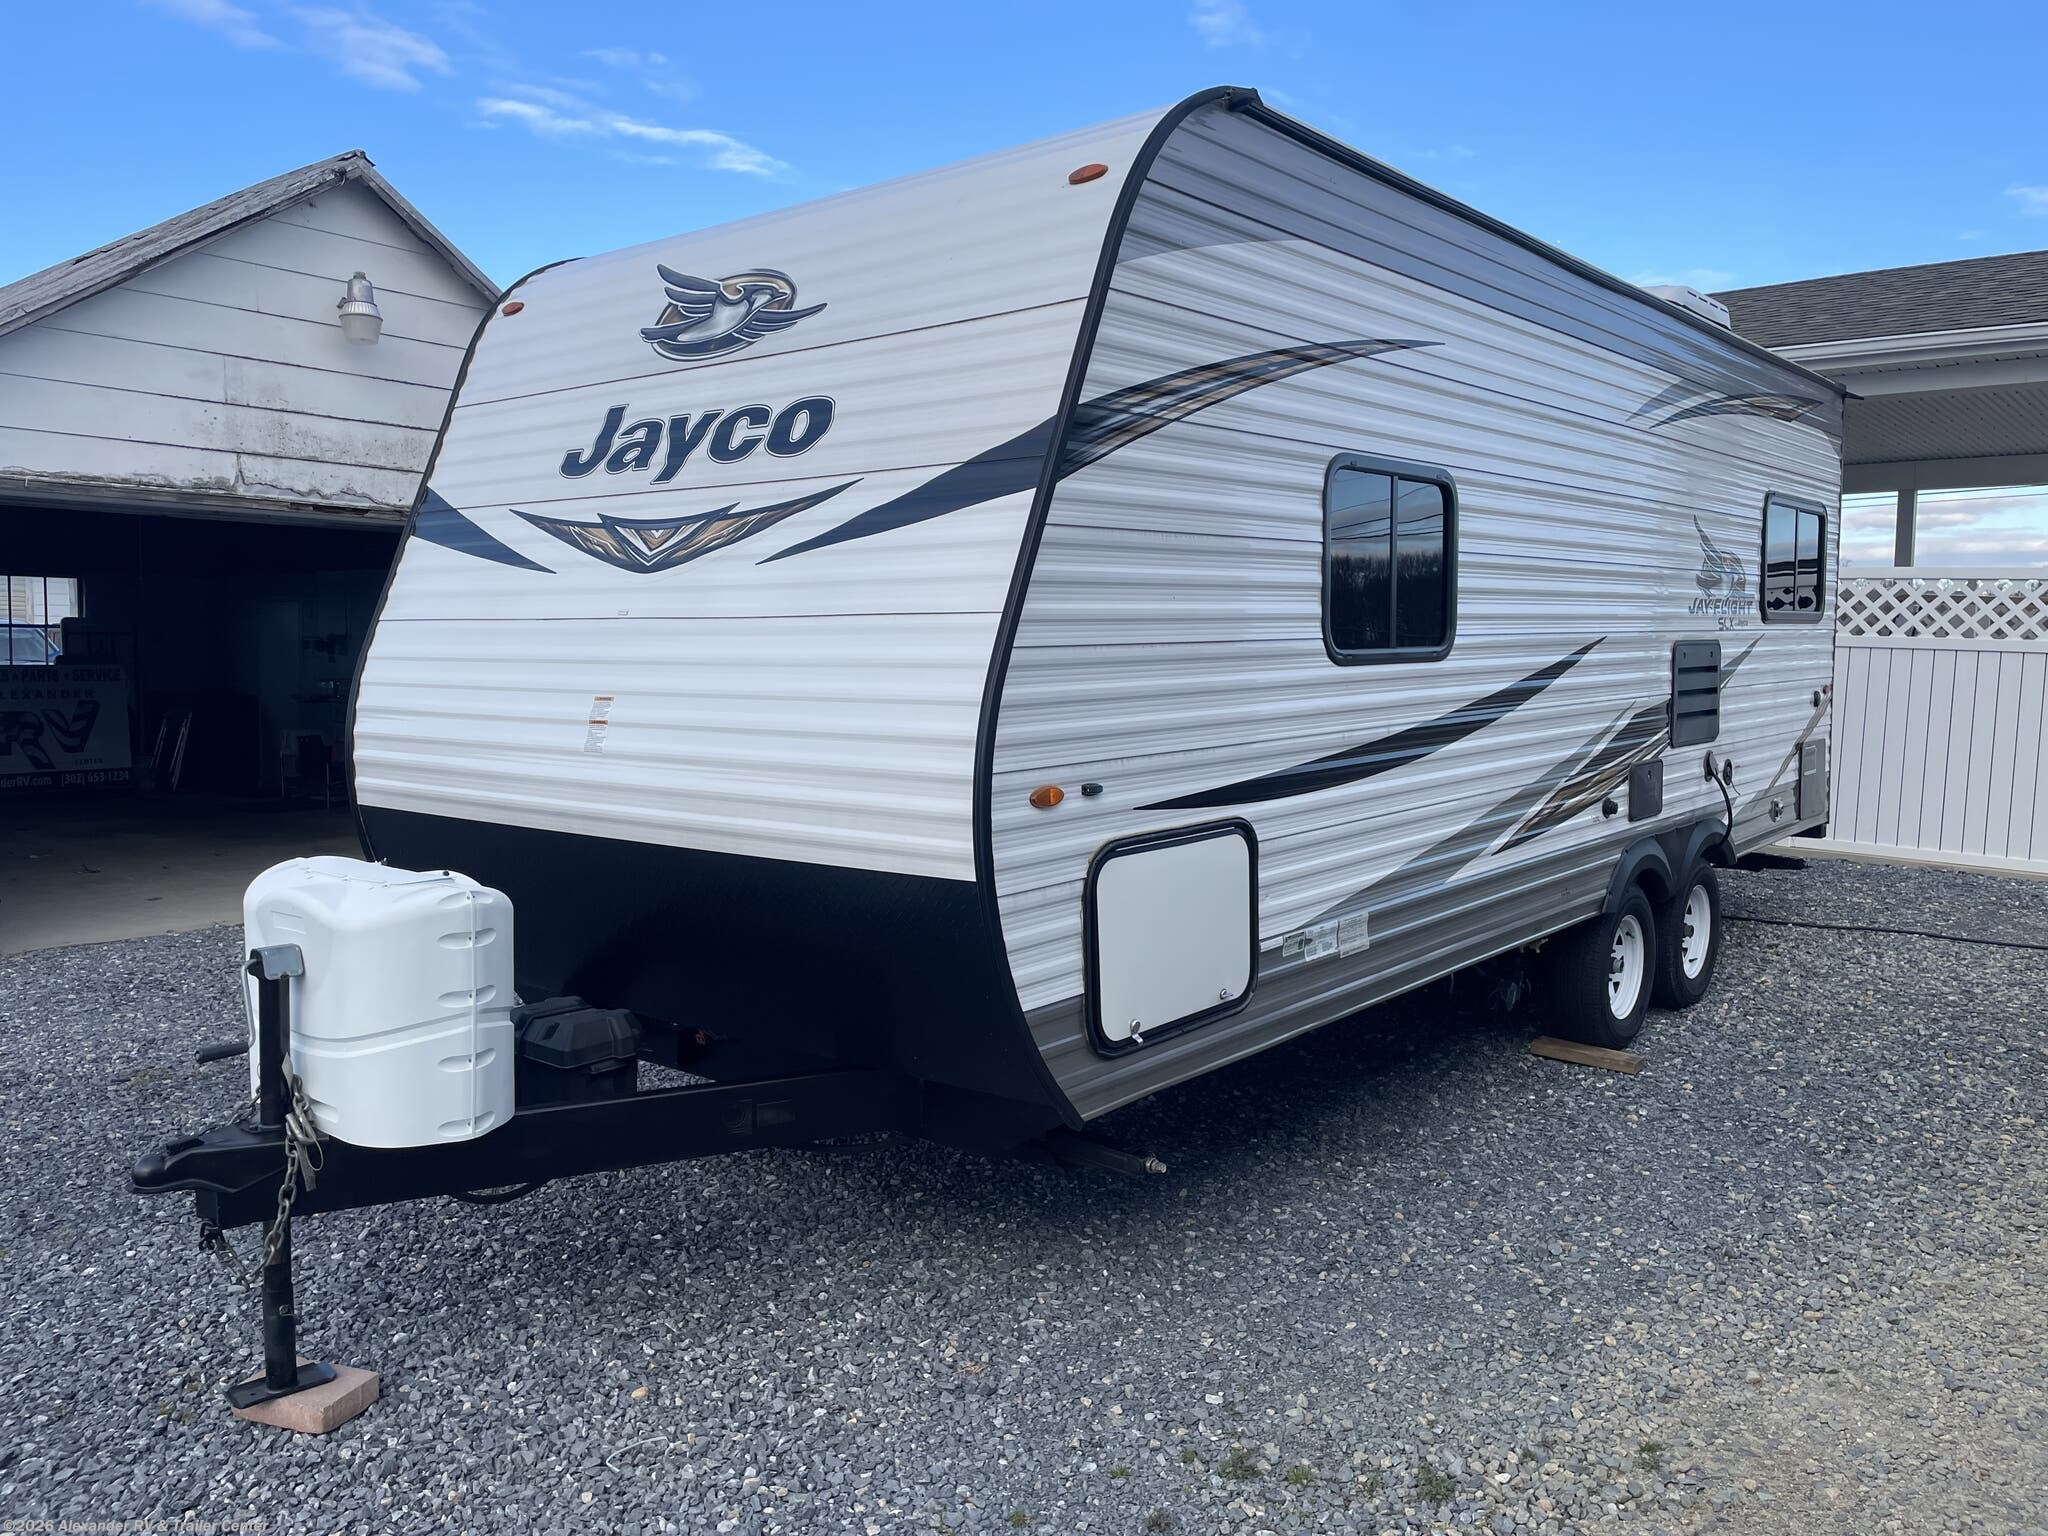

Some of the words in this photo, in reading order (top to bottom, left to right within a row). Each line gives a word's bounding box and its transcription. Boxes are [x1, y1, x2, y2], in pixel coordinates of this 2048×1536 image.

[559, 395, 835, 485] Jayco
[1713, 597, 1753, 615] FLIGHT
[1717, 616, 1735, 631] SLX
[22, 668, 59, 682] PARTS
[72, 667, 121, 682] SERVICE
